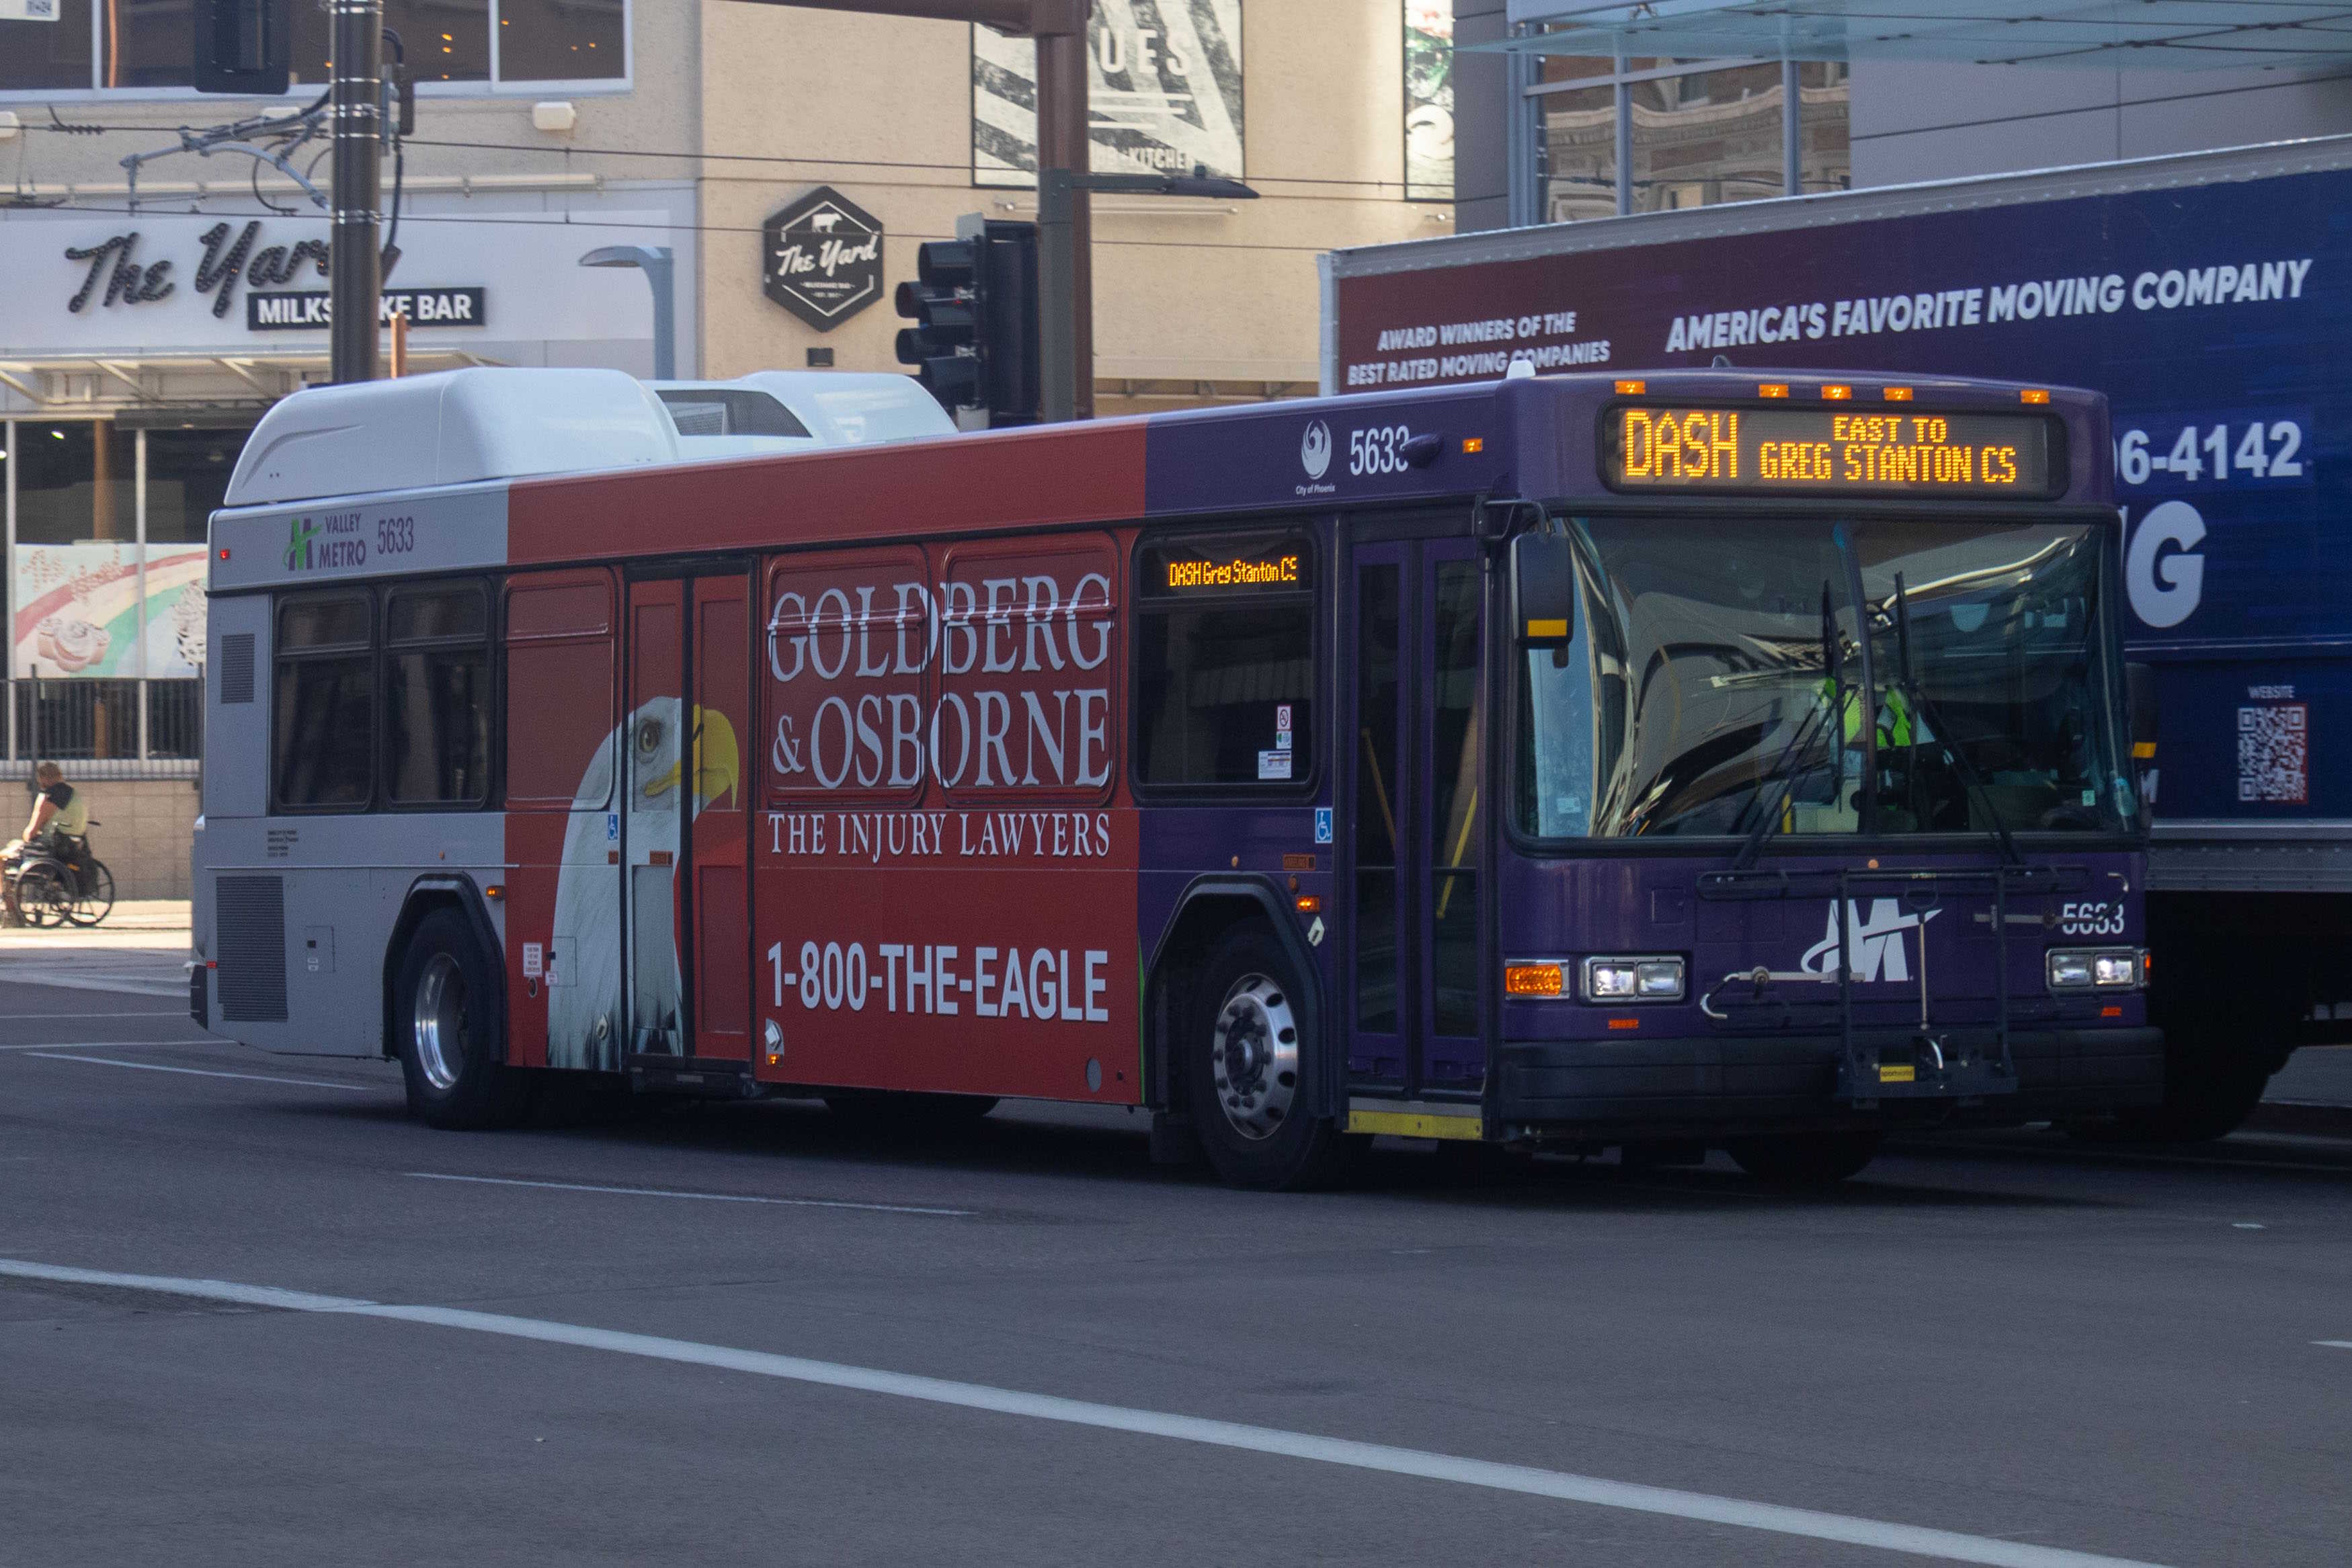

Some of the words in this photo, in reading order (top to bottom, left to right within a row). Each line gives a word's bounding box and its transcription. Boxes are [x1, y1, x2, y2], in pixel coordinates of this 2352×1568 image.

[65, 232, 175, 313] The
[195, 221, 331, 319] Yar
[775, 244, 816, 276] The
[819, 233, 879, 278] Yard
[258, 294, 411, 325] MILKSKE
[417, 293, 473, 321] BAR
[1665, 302, 1828, 353] AMERICA'S
[1831, 287, 1984, 337] FAVORITE
[1987, 274, 2126, 323] MOVING
[2132, 258, 2313, 311] COMPANY
[1377, 325, 1437, 352] AWARD
[1439, 318, 1515, 345] WINNERS
[1516, 315, 1541, 338] OF
[1543, 311, 1577, 334] THE
[1346, 362, 1387, 386] BEST
[1387, 358, 1438, 383] RATED
[1440, 350, 1508, 378] MOVING
[1350, 424, 1410, 476] 5633
[1625, 411, 1738, 479] DASH
[1833, 415, 1902, 443] EAST
[1912, 417, 1948, 444] TO
[1759, 441, 1832, 480] GREG
[1843, 444, 1973, 483] STANTON
[1981, 446, 2017, 484] CS
[2113, 420, 2303, 485] 6-4142
[325, 513, 362, 534] VALLEY
[378, 517, 414, 554] 5633
[319, 540, 366, 569] METRO
[1169, 561, 1201, 587] DASH
[1203, 561, 1231, 585] Greg
[1233, 559, 1279, 583] Stanton
[1281, 555, 1297, 581] CS
[767, 572, 1115, 682] GOLDBERG
[2248, 685, 2295, 699] WEBSITE
[772, 714, 806, 775] &
[810, 688, 1112, 789] OSBORNE
[768, 813, 826, 856] THE
[838, 813, 946, 864] INJURY
[960, 813, 1110, 858] LAWYERS
[2062, 902, 2125, 936] 5633
[767, 940, 1109, 1023] 1-800-THE-EAGLE
